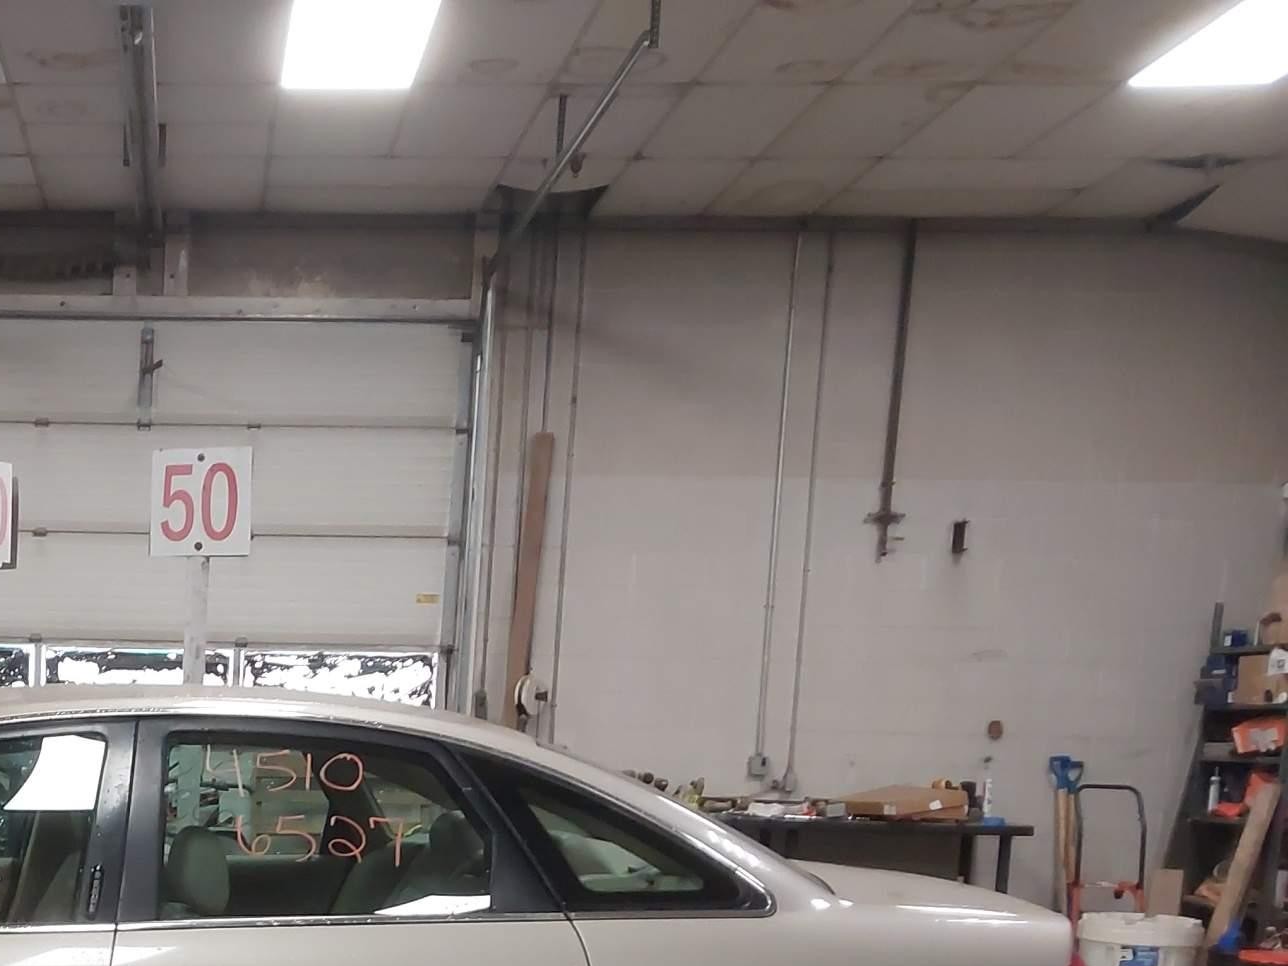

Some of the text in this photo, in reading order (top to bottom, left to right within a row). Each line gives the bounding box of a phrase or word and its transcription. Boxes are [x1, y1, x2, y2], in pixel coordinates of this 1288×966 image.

[160, 461, 239, 542] 50
[206, 744, 364, 797] 4510
[235, 815, 405, 867] 6527
